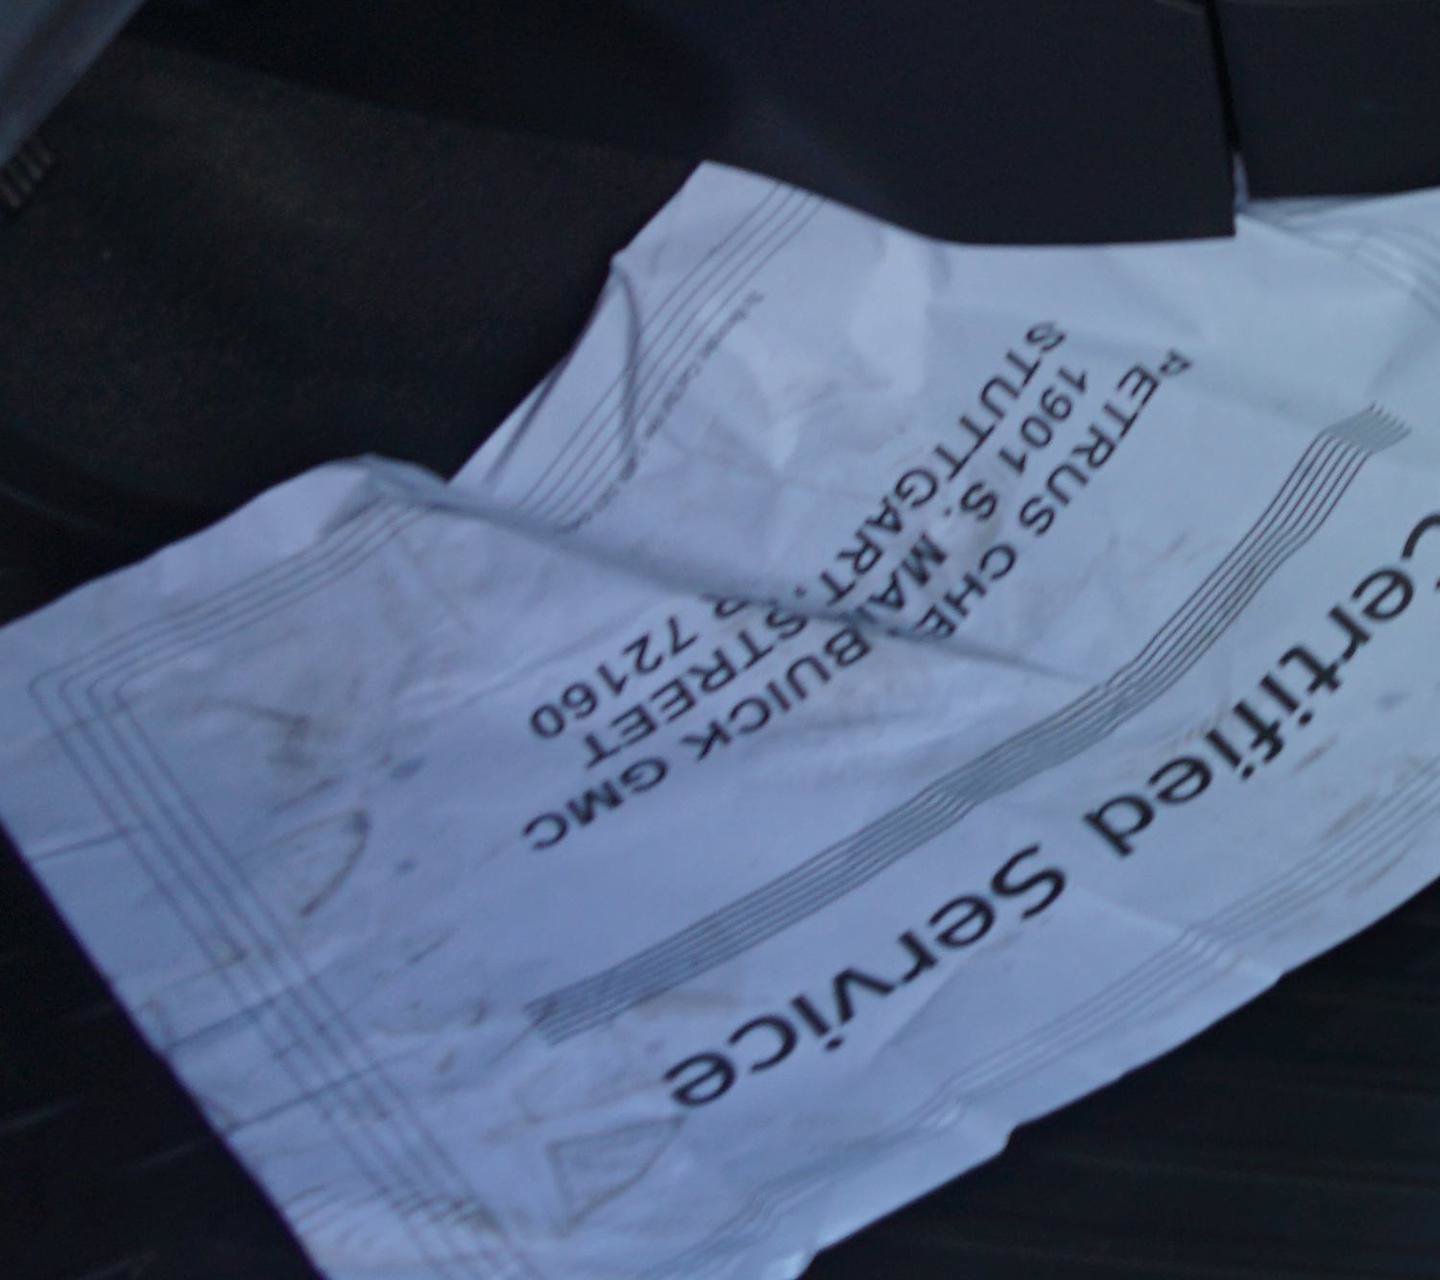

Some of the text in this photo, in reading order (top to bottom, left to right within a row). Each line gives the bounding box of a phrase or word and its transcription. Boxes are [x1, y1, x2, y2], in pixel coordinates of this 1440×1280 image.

[998, 366, 1089, 477] 1901
[942, 480, 999, 522] S.
[522, 348, 1193, 851] PETRUS CHE BUICK GMC
[529, 614, 699, 739] 72160
[584, 602, 809, 769] STREET
[662, 843, 1067, 1109] Service
